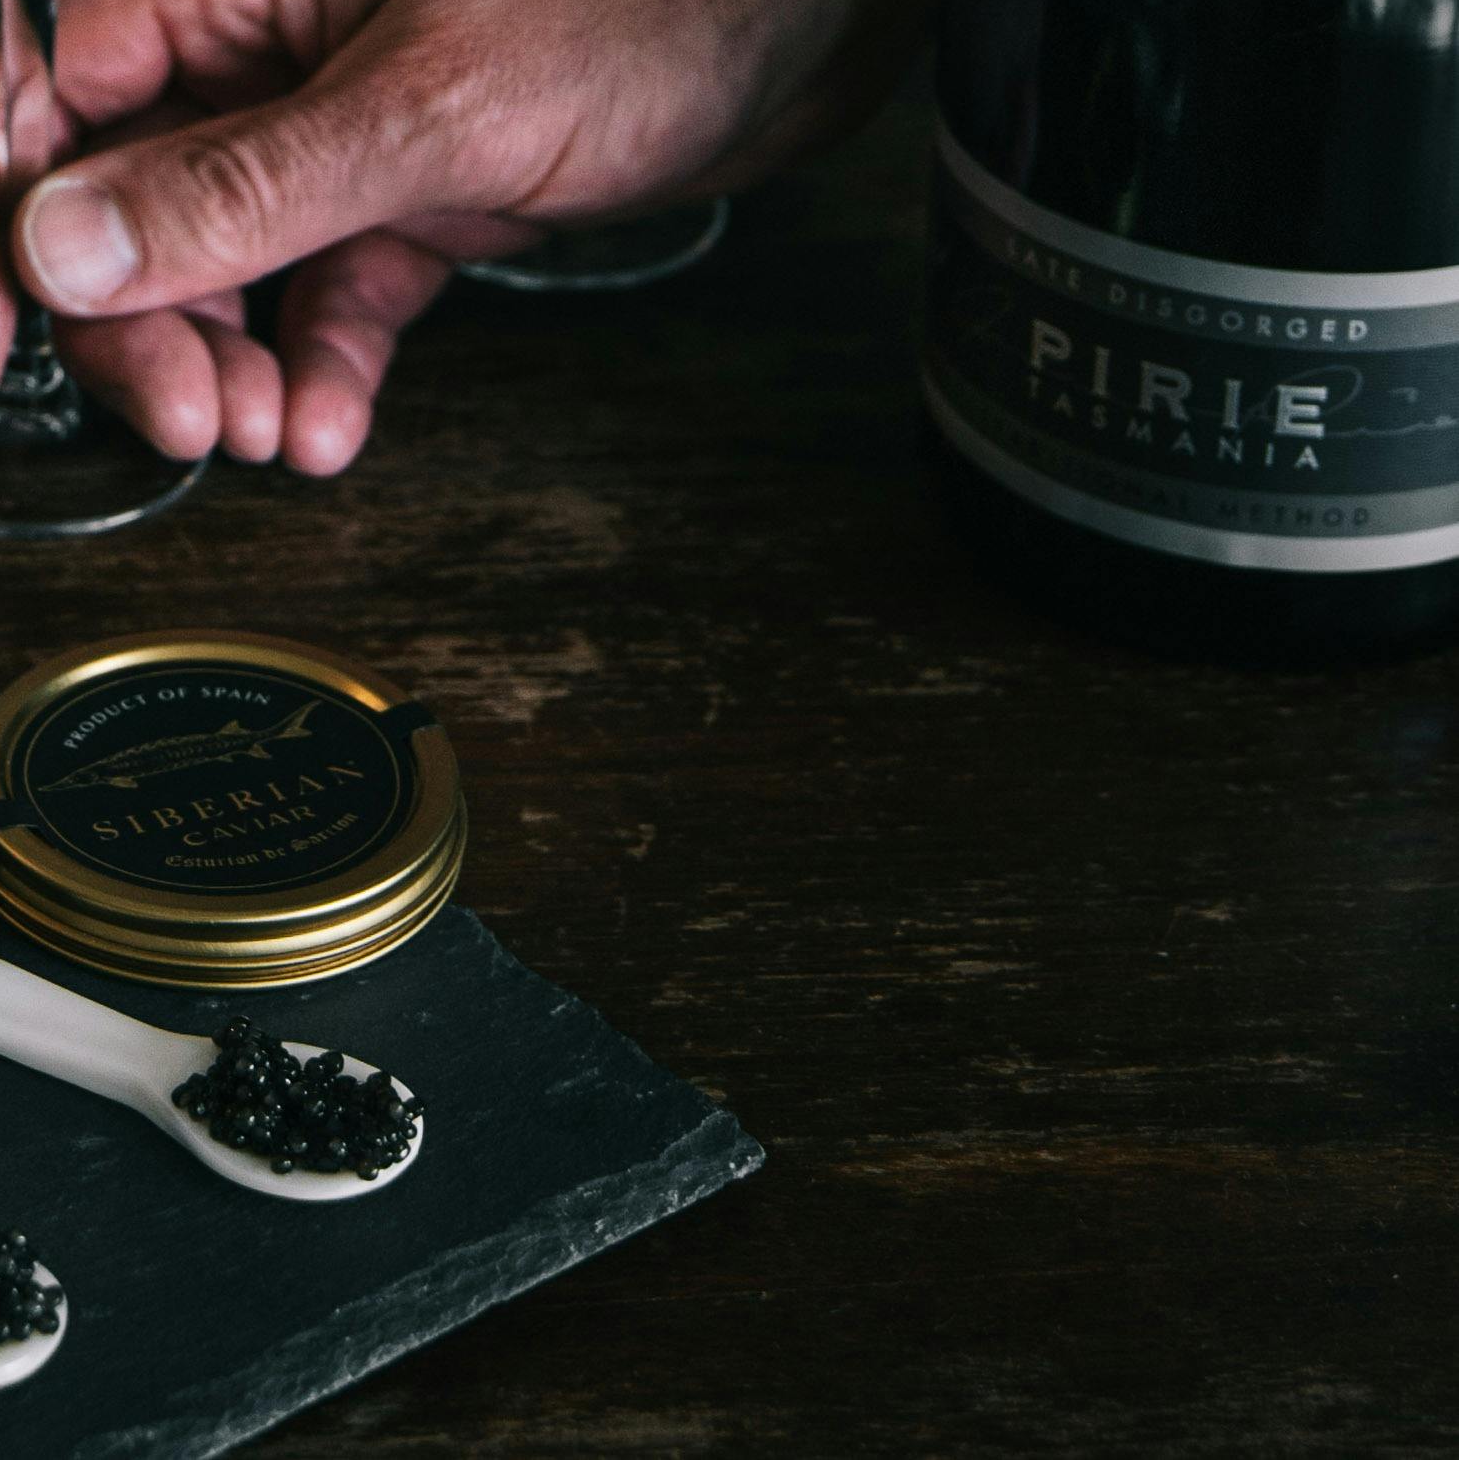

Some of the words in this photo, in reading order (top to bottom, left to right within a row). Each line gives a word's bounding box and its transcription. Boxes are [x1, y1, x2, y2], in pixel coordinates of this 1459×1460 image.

[1005, 236, 1082, 291] LATE
[1108, 283, 1370, 343] DISGORGED
[1027, 317, 1329, 440] PIRIE
[1027, 374, 1322, 472] TASMANIA
[1214, 499, 1371, 528] METHOD
[63, 692, 148, 751] PRODUCT
[157, 685, 190, 703] OF
[200, 686, 273, 706] SPAIN
[91, 761, 367, 842] SIBERIAN
[182, 804, 318, 847] CAVIAR
[261, 846, 286, 860] de
